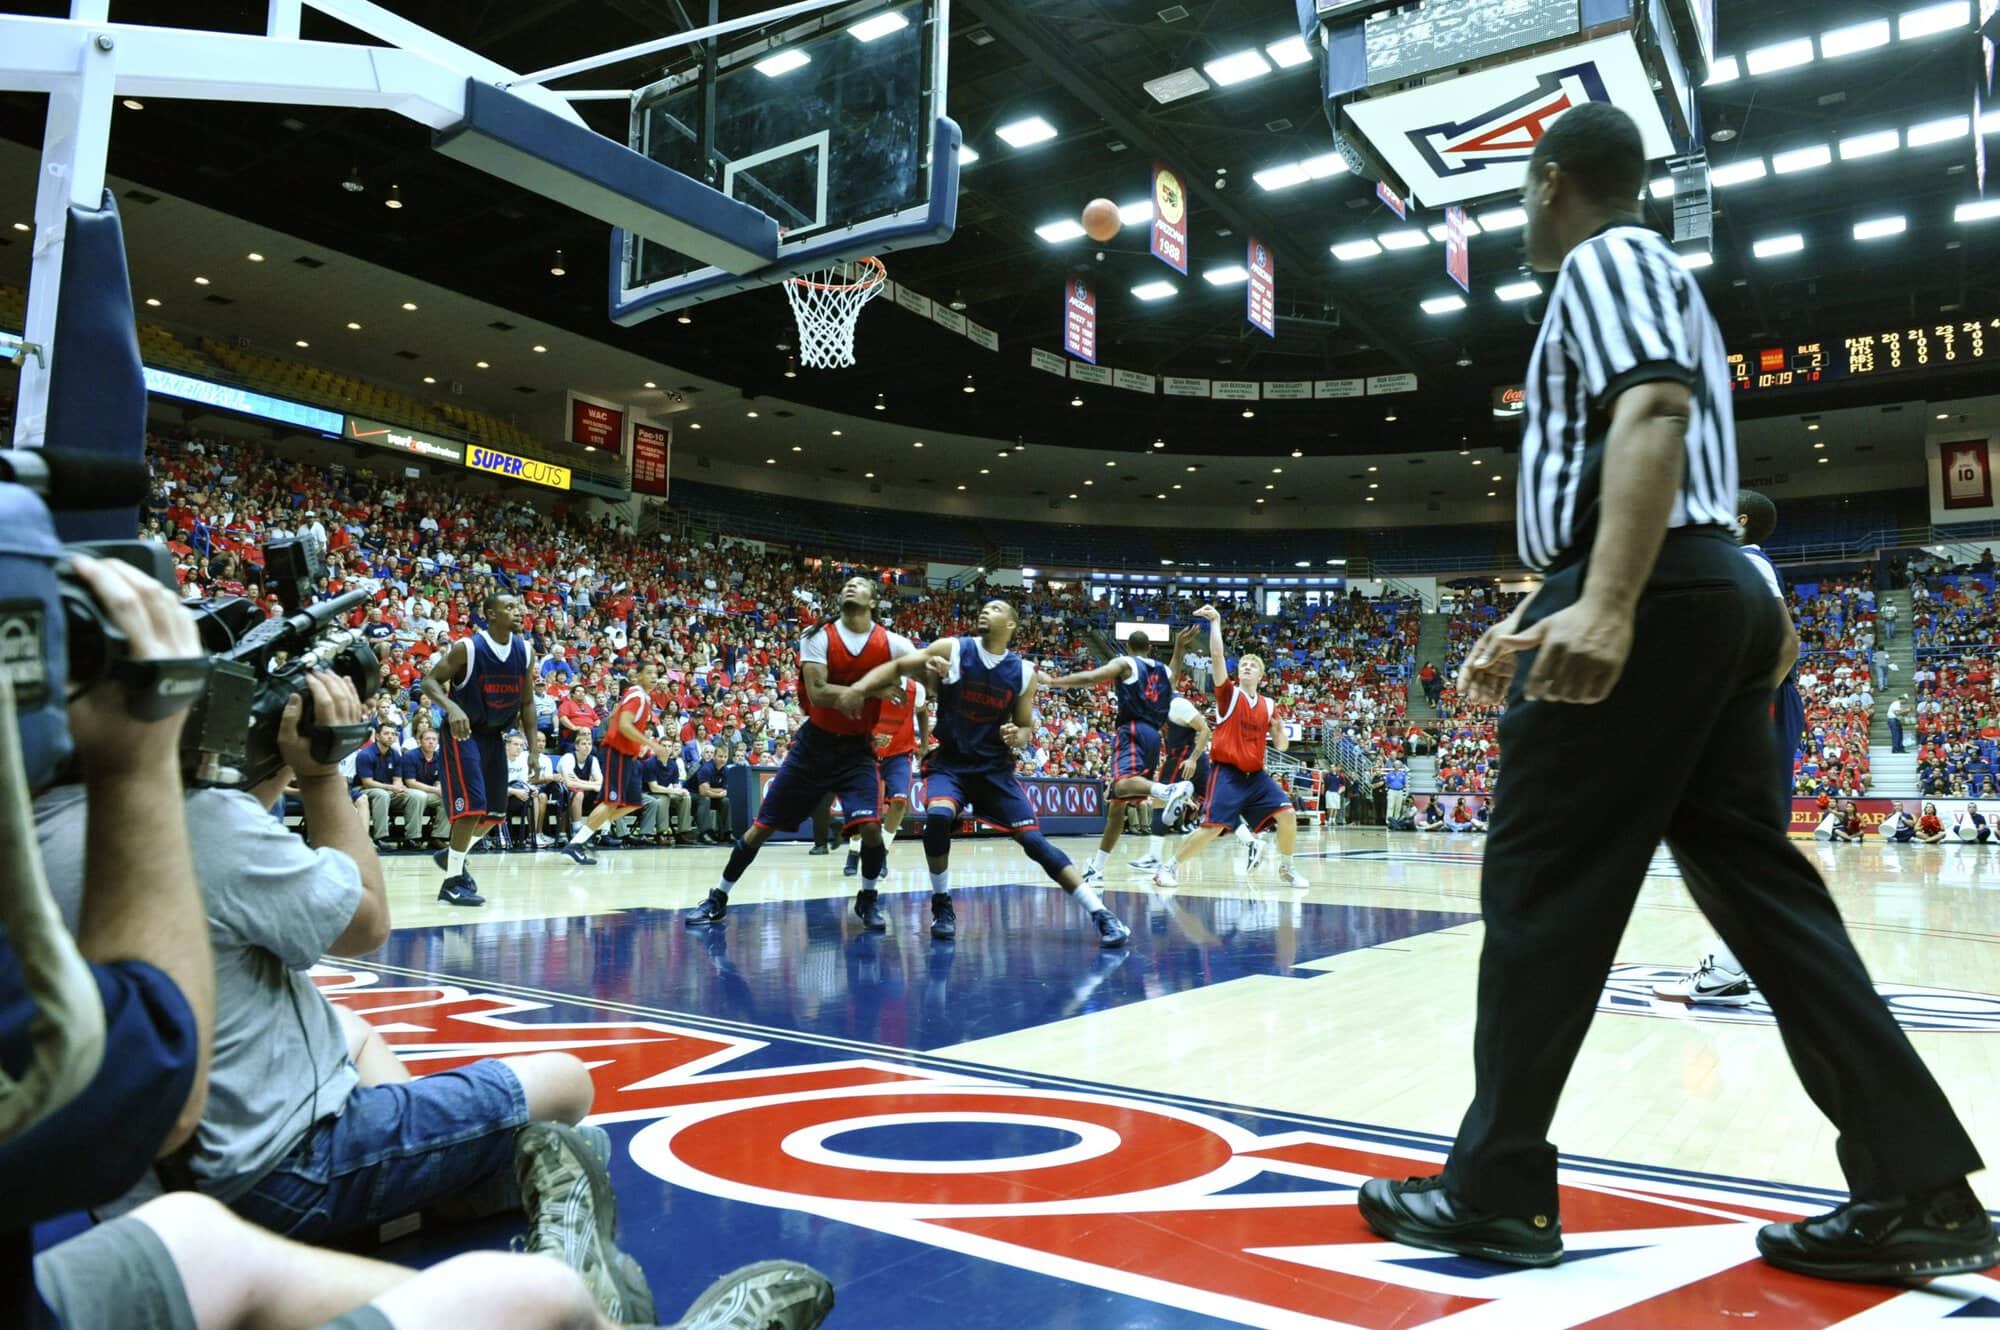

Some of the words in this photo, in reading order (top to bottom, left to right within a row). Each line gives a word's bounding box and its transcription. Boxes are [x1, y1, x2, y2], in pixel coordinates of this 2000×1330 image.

[1156, 219, 1184, 245] ARIZONA
[1160, 238, 1180, 262] 1988
[1845, 336, 1874, 348] PLYR
[1882, 333, 1899, 343] 20
[1908, 329, 1923, 340] 21
[1936, 325, 1954, 335] 23
[1963, 322, 1981, 332] 24
[1851, 346, 1871, 355] PTS
[1890, 342, 1900, 350] 0
[1917, 338, 1927, 347] 0
[1944, 334, 1954, 343] 2
[1972, 330, 1982, 339] 0
[1798, 344, 1820, 354] BLUE
[1850, 354, 1873, 364] RBS
[1891, 350, 1900, 359] 0
[1918, 346, 1928, 355] 0
[1946, 343, 1952, 351] 1
[1973, 339, 1983, 348] 0
[1737, 364, 1746, 376] 0
[1812, 354, 1821, 366] 2
[1850, 362, 1874, 373] FLS
[1891, 358, 1900, 367] 0
[1918, 355, 1928, 364] 0
[1946, 351, 1955, 360] 0
[1973, 348, 1983, 357] 0
[1759, 372, 1792, 388] 10:19
[588, 408, 608, 421] WAC
[387, 433, 428, 454] verizon
[639, 429, 664, 441] Pac-10
[472, 448, 562, 485] SUPERCUTS
[1958, 469, 1974, 482] 10
